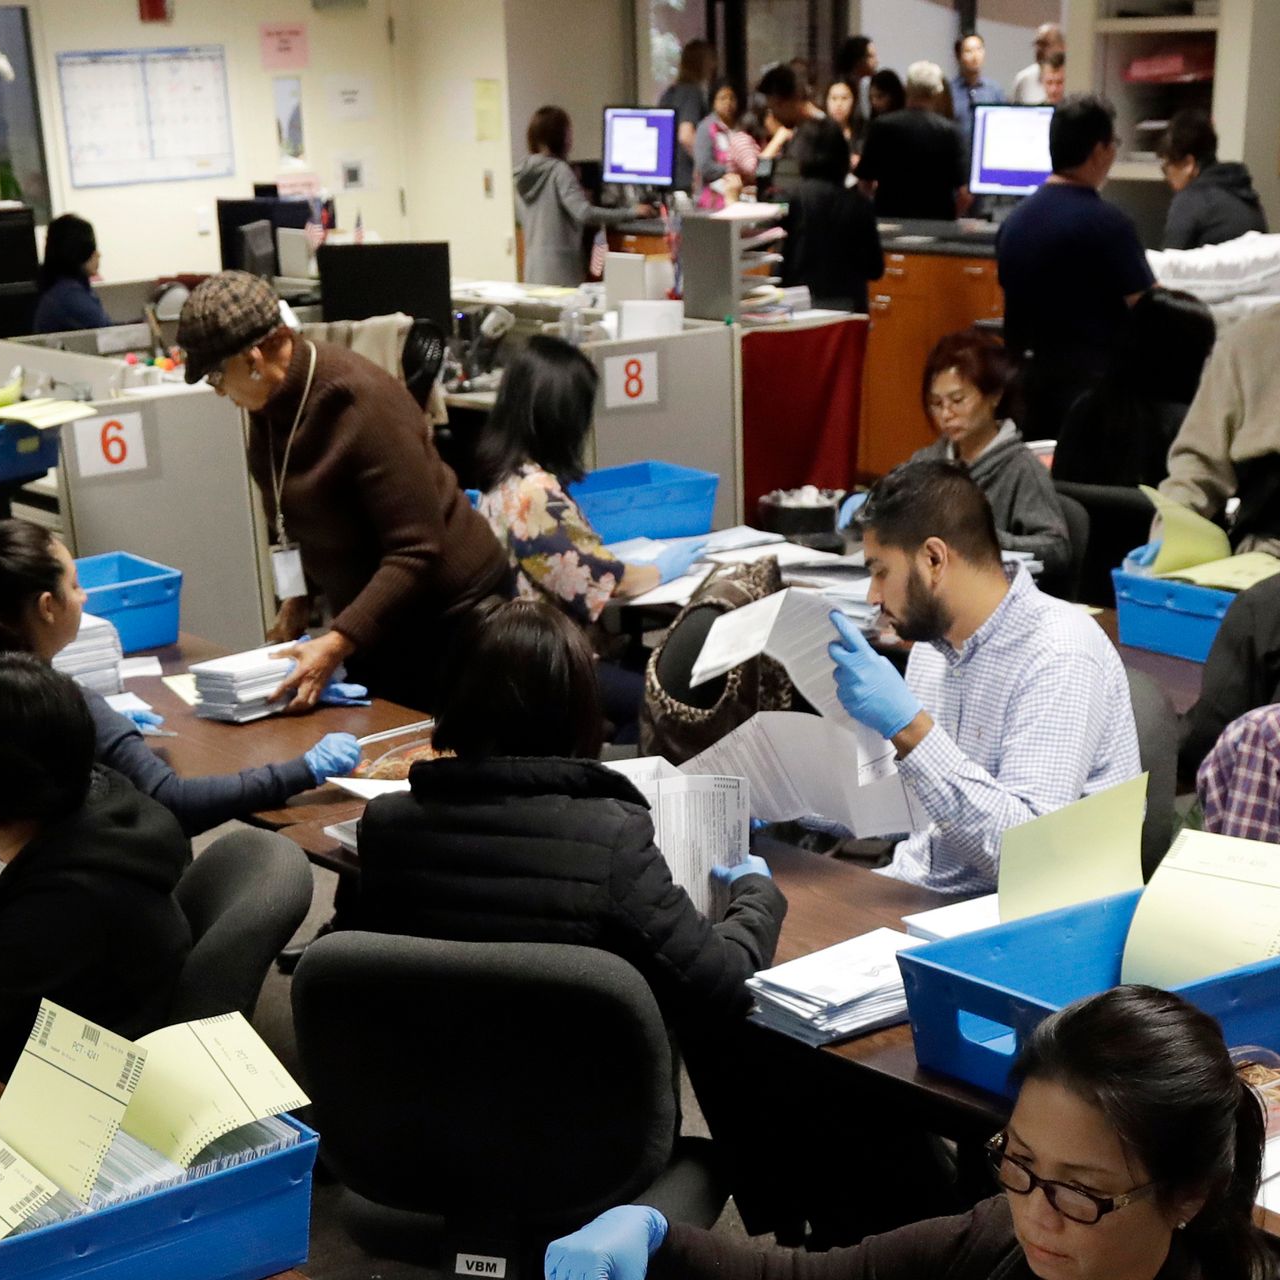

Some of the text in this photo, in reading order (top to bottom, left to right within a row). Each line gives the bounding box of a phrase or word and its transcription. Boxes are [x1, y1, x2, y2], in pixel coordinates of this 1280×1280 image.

[624, 358, 644, 399] 8
[100, 420, 128, 465] 6
[465, 1259, 499, 1277] VBM
